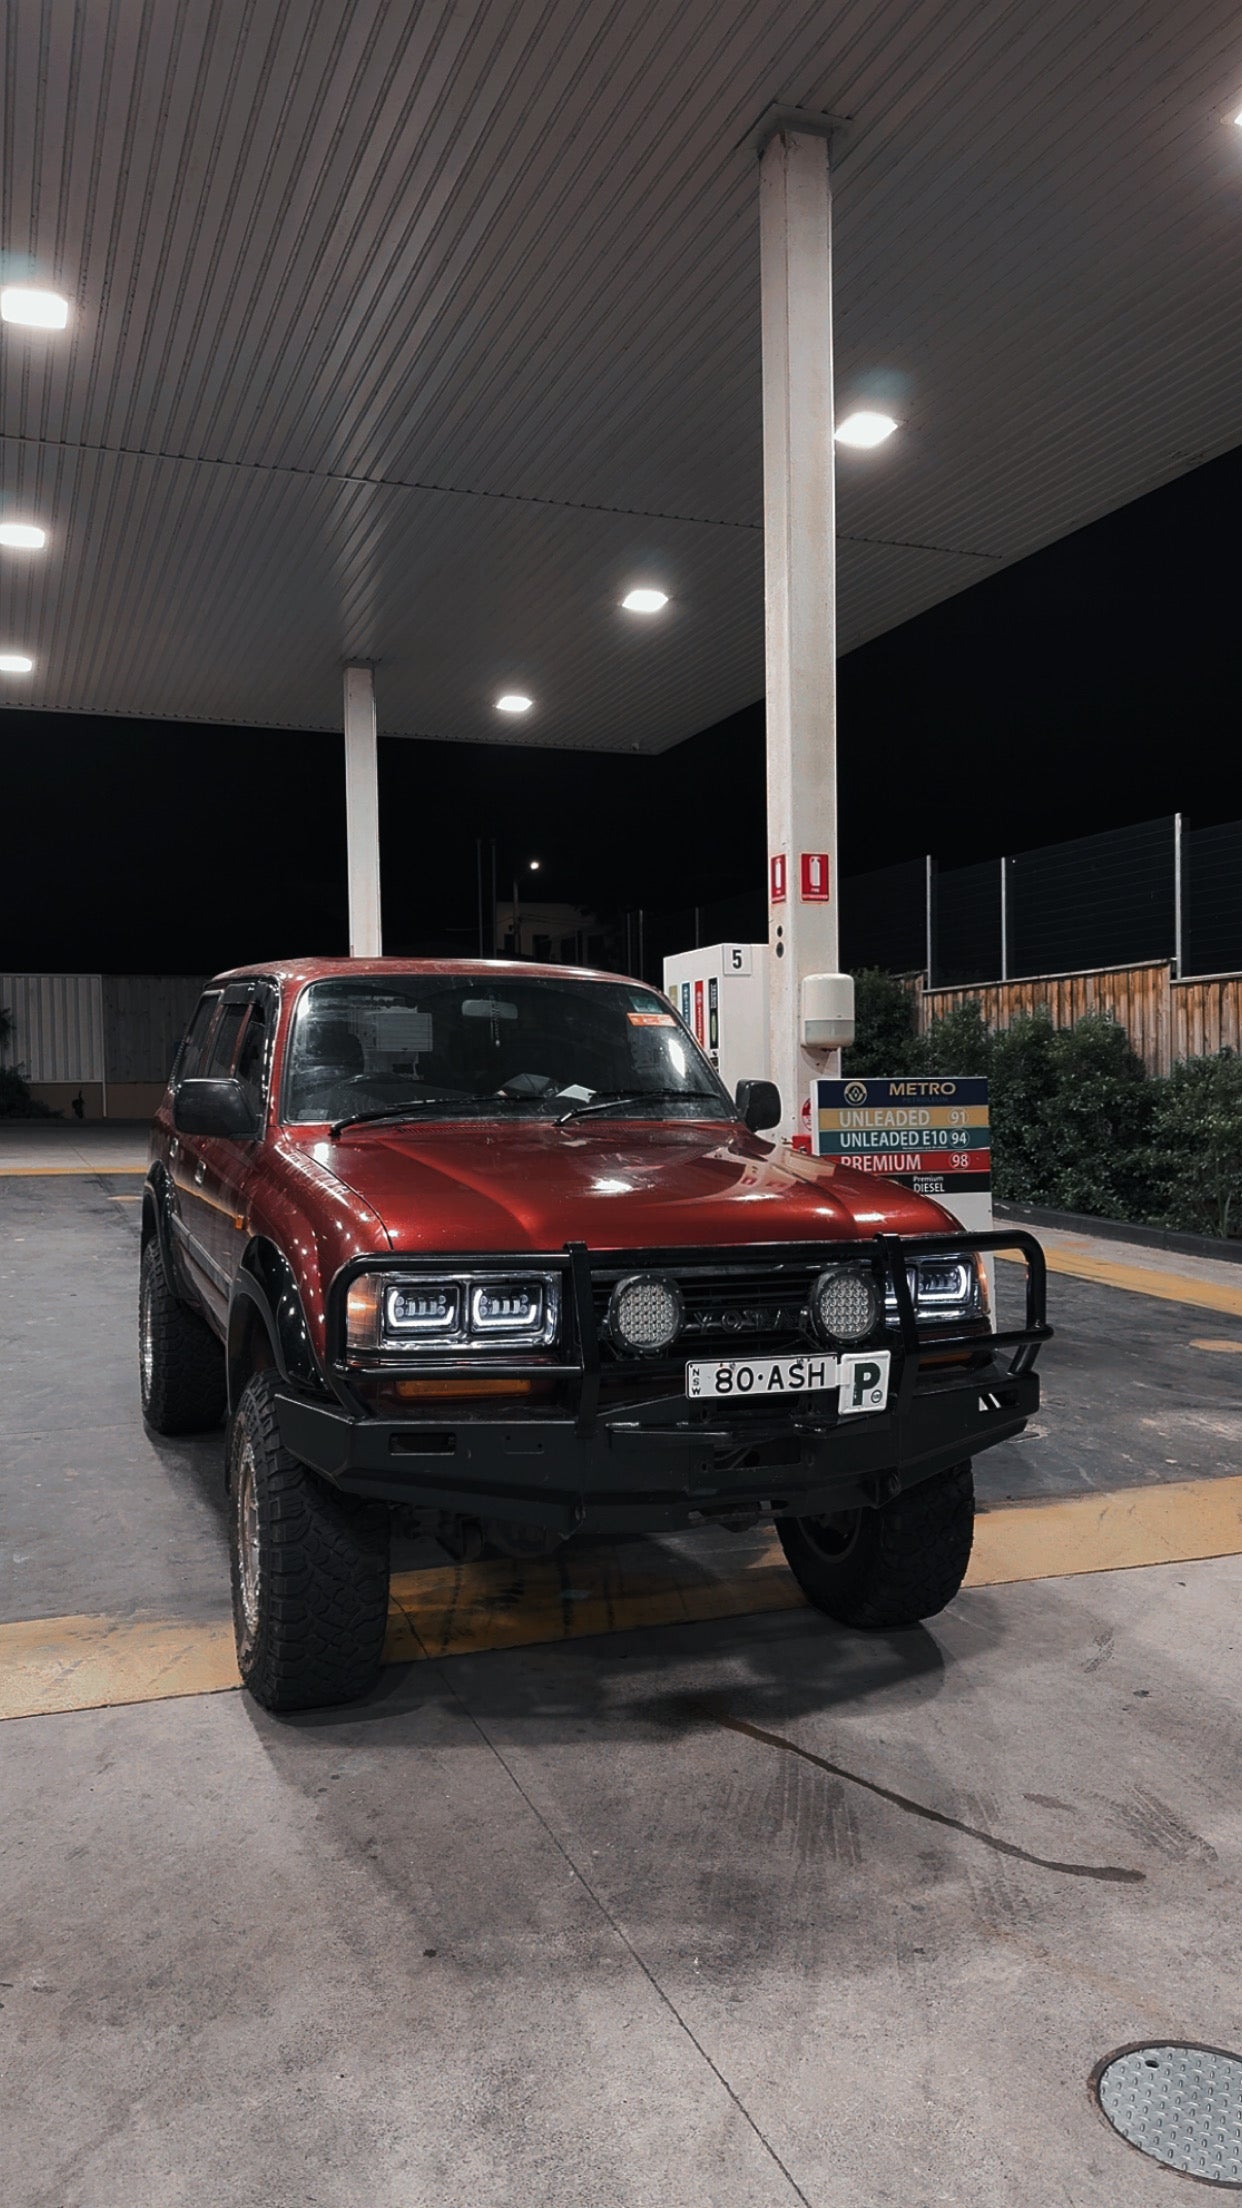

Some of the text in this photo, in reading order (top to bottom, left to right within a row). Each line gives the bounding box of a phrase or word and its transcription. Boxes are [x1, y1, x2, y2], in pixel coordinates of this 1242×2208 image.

[732, 949, 743, 969] 5
[889, 1082, 956, 1096] METRO
[839, 1110, 966, 1127] UNLEADED 91
[840, 1129, 967, 1148] UNLEADED E10 94
[841, 1154, 969, 1171] PREMIUM 98
[913, 1183, 945, 1193] DIESEL
[852, 1362, 881, 1406] P
